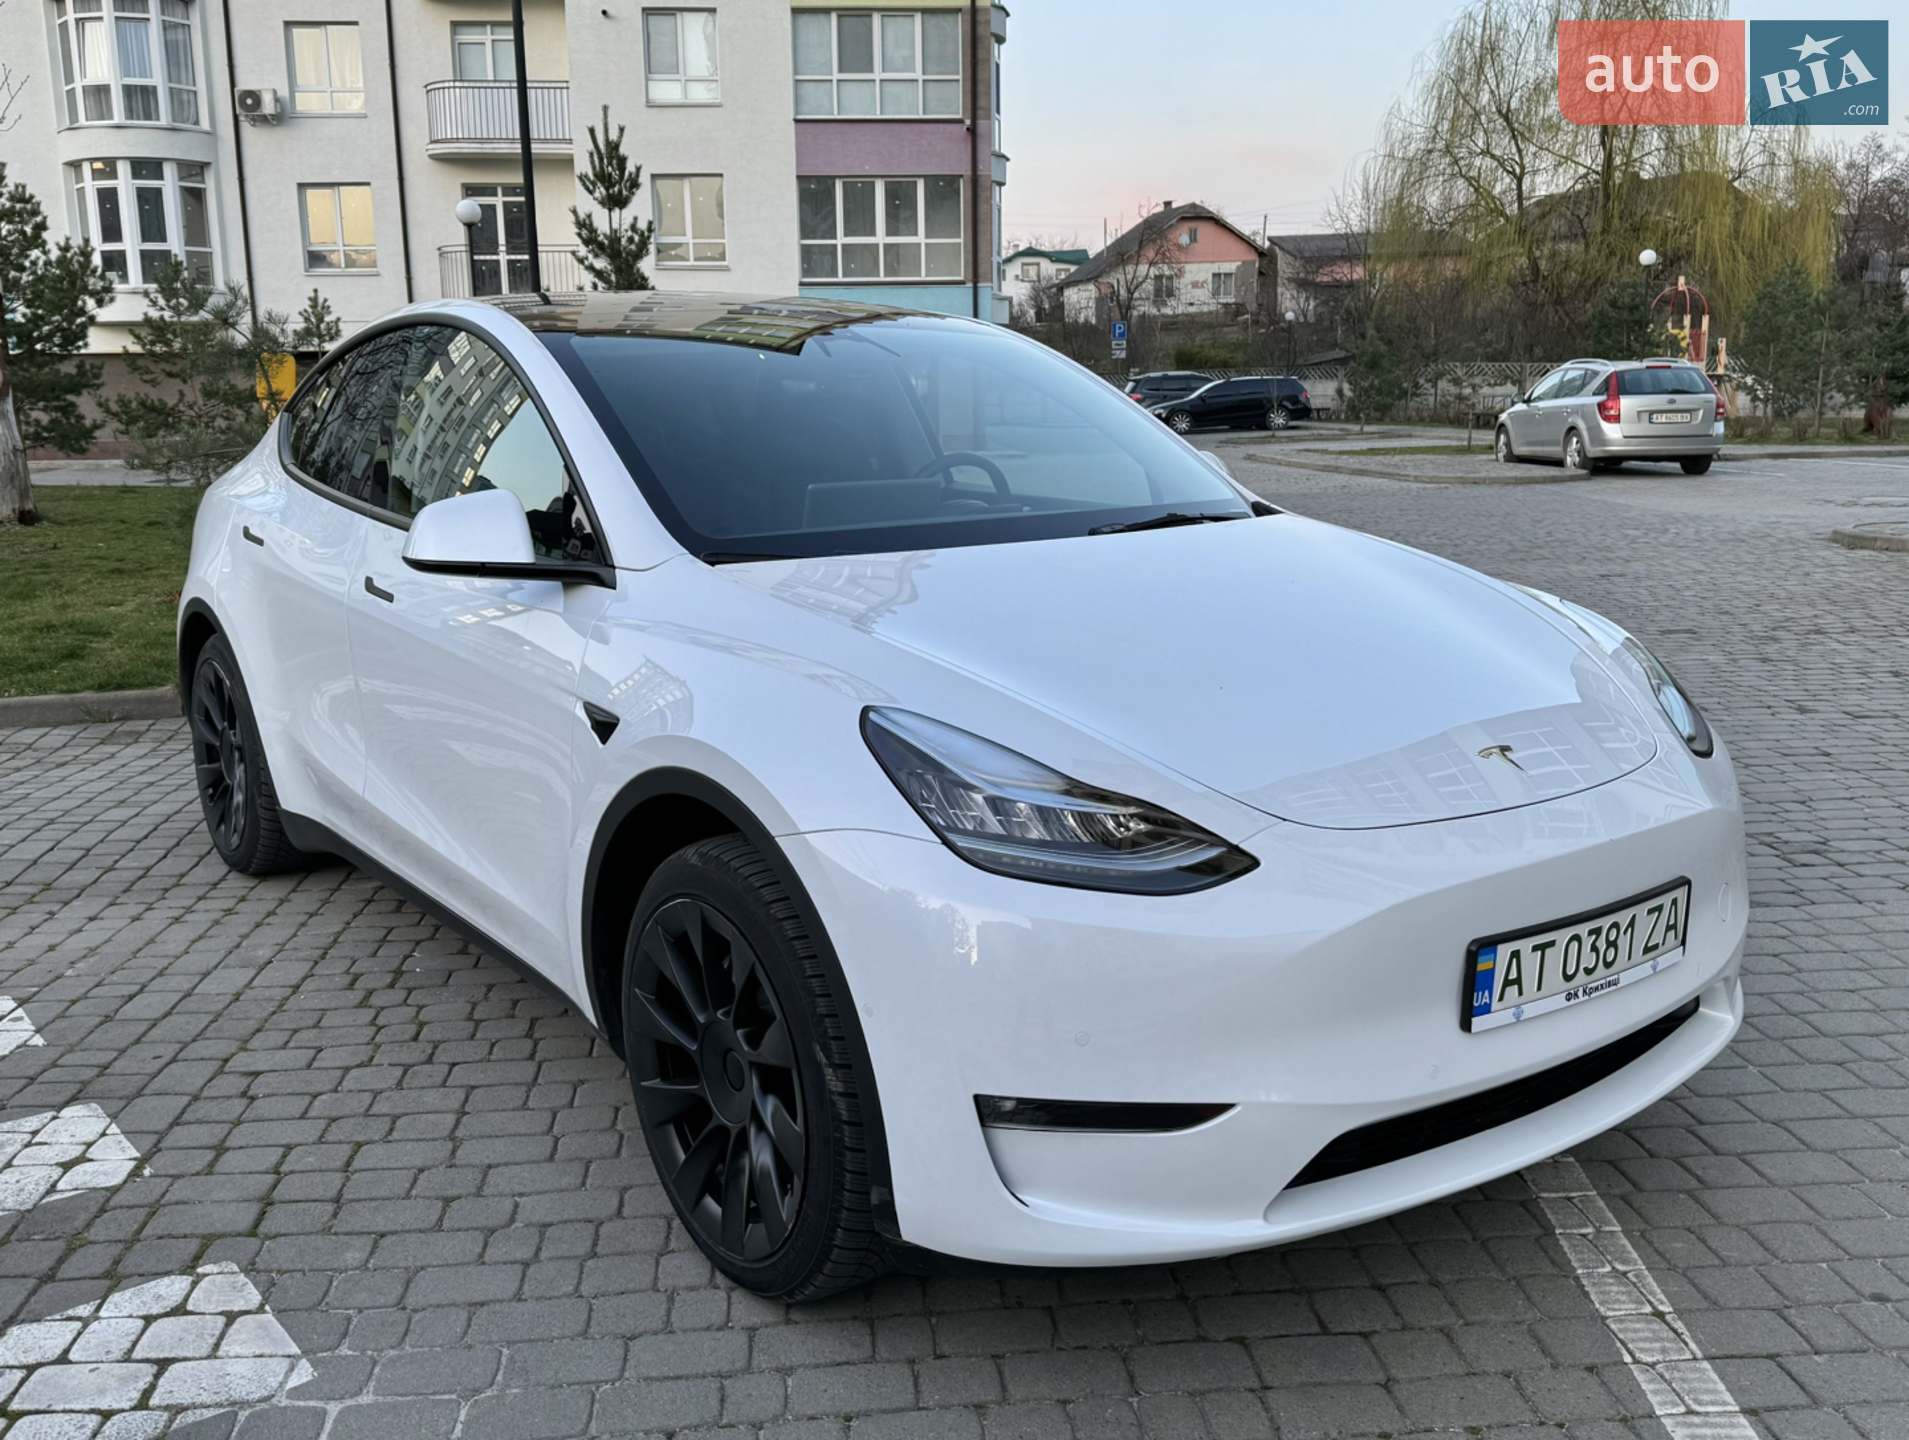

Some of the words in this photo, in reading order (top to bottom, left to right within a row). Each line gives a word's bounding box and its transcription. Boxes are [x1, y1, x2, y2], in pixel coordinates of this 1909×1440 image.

[1115, 323, 1125, 338] P
[1497, 938, 1557, 1002] AT
[1561, 912, 1637, 983] 0381
[1641, 896, 1679, 957] ZA
[1473, 989, 1491, 1007] UA
[1565, 988, 1580, 1003] ФК
[1582, 974, 1621, 998] Крихівці
